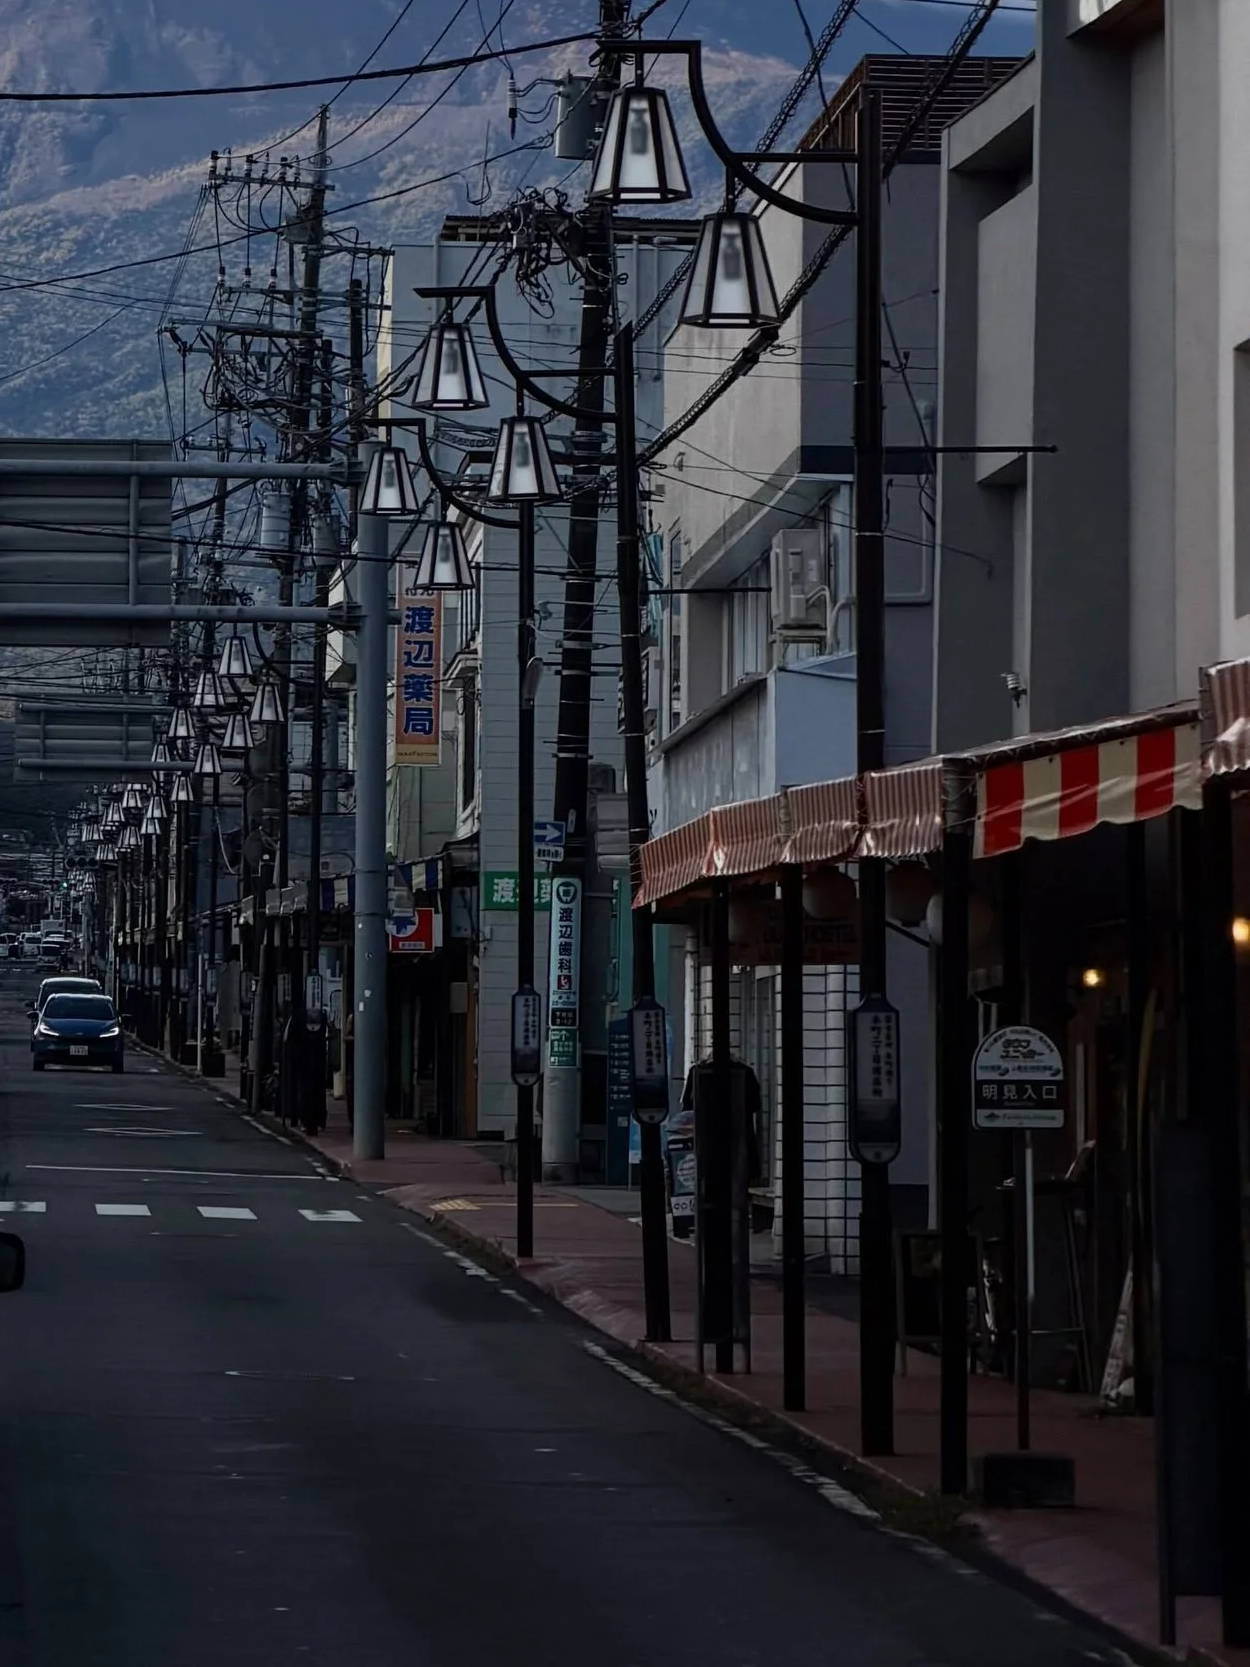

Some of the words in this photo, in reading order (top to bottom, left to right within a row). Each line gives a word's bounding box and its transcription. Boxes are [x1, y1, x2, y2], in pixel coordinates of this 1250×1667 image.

[404, 606, 435, 735] 渡辺薬局
[558, 907, 574, 974] 渡辺歯科
[981, 1083, 1058, 1101] 明見入口
